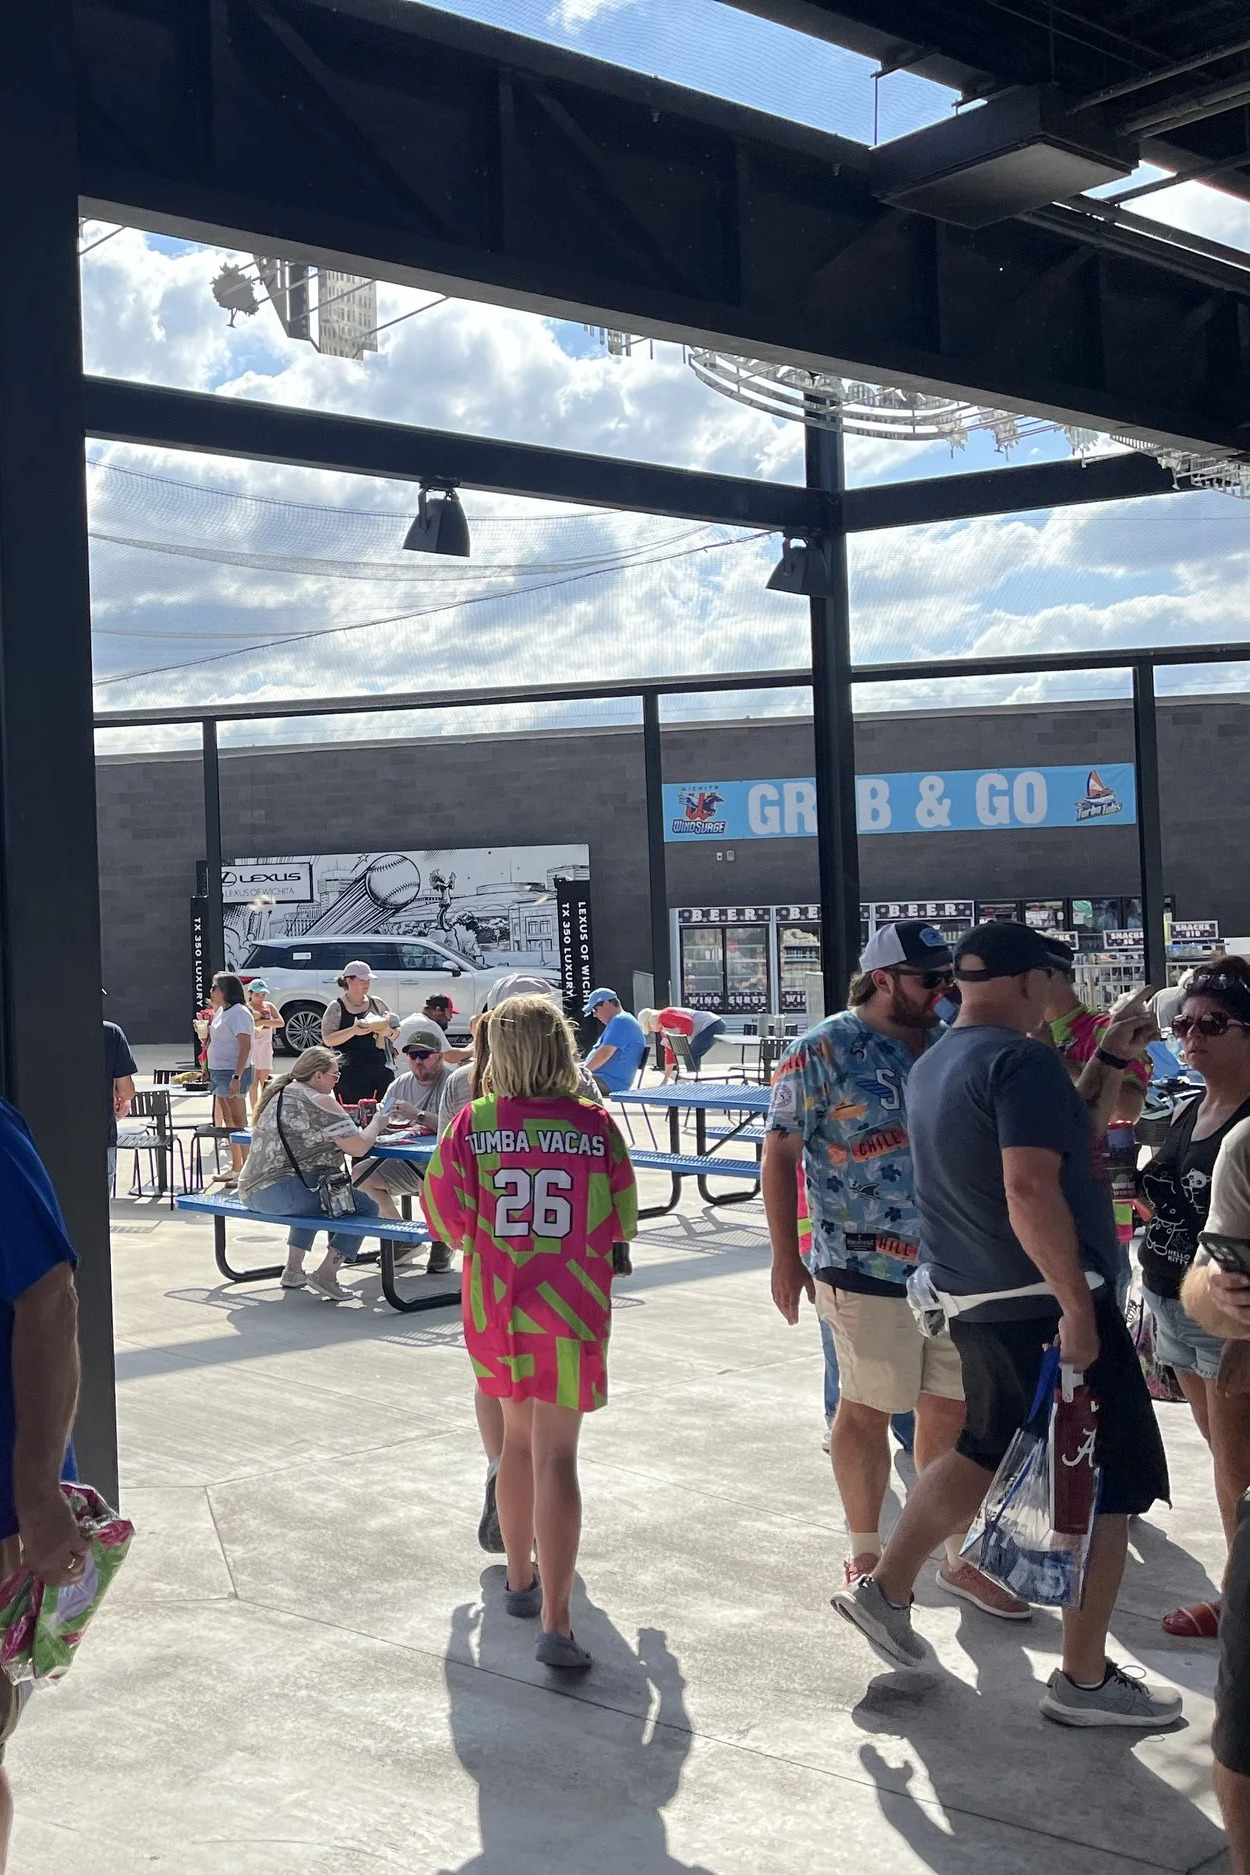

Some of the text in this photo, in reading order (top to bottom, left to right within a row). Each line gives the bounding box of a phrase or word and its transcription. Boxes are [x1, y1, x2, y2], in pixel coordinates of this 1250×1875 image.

[915, 775, 952, 828] &
[976, 772, 1048, 827] GO
[240, 872, 302, 883] LEXUS
[225, 887, 295, 897] LEXUS OF WICHITA
[692, 908, 757, 922] BEER
[789, 906, 819, 920] BE
[889, 903, 957, 917] BEER
[578, 901, 588, 941] LEXUS
[1175, 923, 1210, 932] SNACKS
[1110, 932, 1144, 940] SNACKS
[562, 902, 574, 998] TX 350 LUXURY
[580, 945, 589, 961] OF
[194, 917, 204, 1008] TX 350 LUXURY
[688, 996, 767, 1005] WIND SURGE
[465, 1130, 605, 1157] TUMBA VACAS
[858, 1131, 903, 1157] CHILL
[493, 1167, 573, 1239] 26
[879, 1237, 912, 1258] HILL
[1167, 1249, 1191, 1260] HELLO
[1167, 1256, 1190, 1266] KITTY
